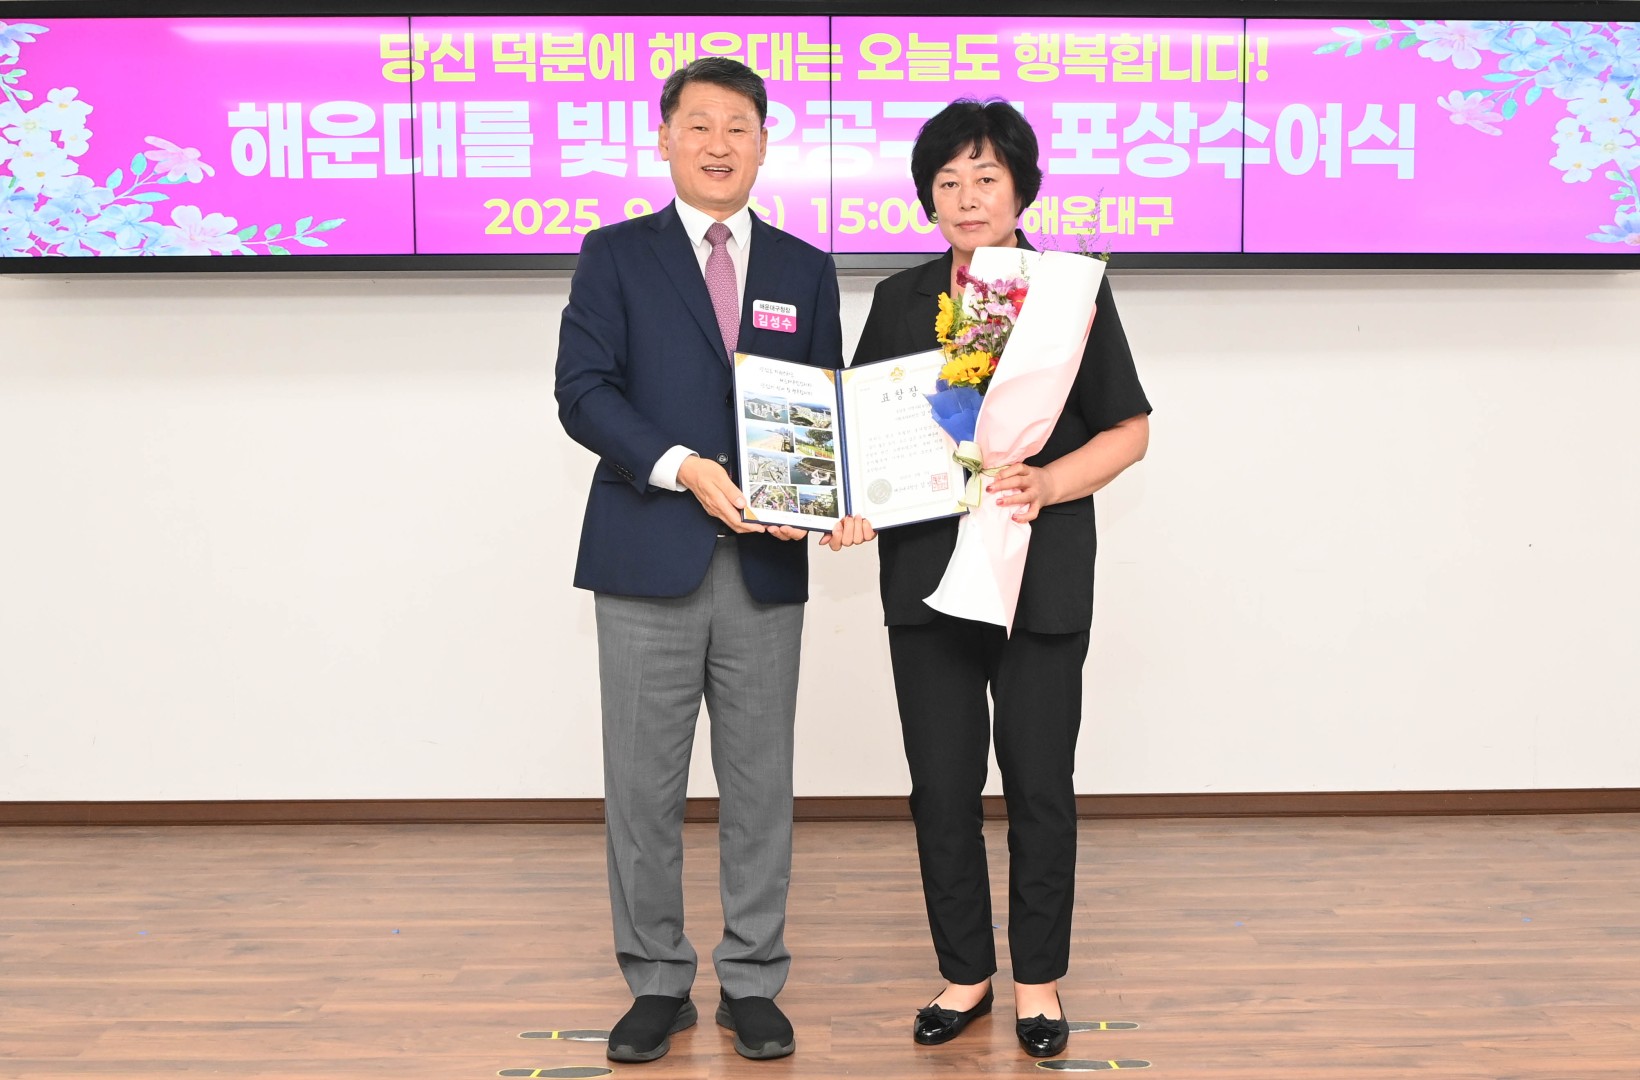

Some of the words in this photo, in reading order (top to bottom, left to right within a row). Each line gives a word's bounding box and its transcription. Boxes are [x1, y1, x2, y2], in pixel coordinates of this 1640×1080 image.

[379, 32, 476, 83] 당신
[492, 32, 634, 82] 덕분에
[858, 32, 1000, 82] 오늘도
[1013, 33, 1269, 83] 행복합니다!
[228, 101, 534, 179] 해운대를
[1048, 102, 1416, 179] 포상수여식
[1023, 195, 1174, 236] 해운대구
[758, 314, 792, 330] 김성수
